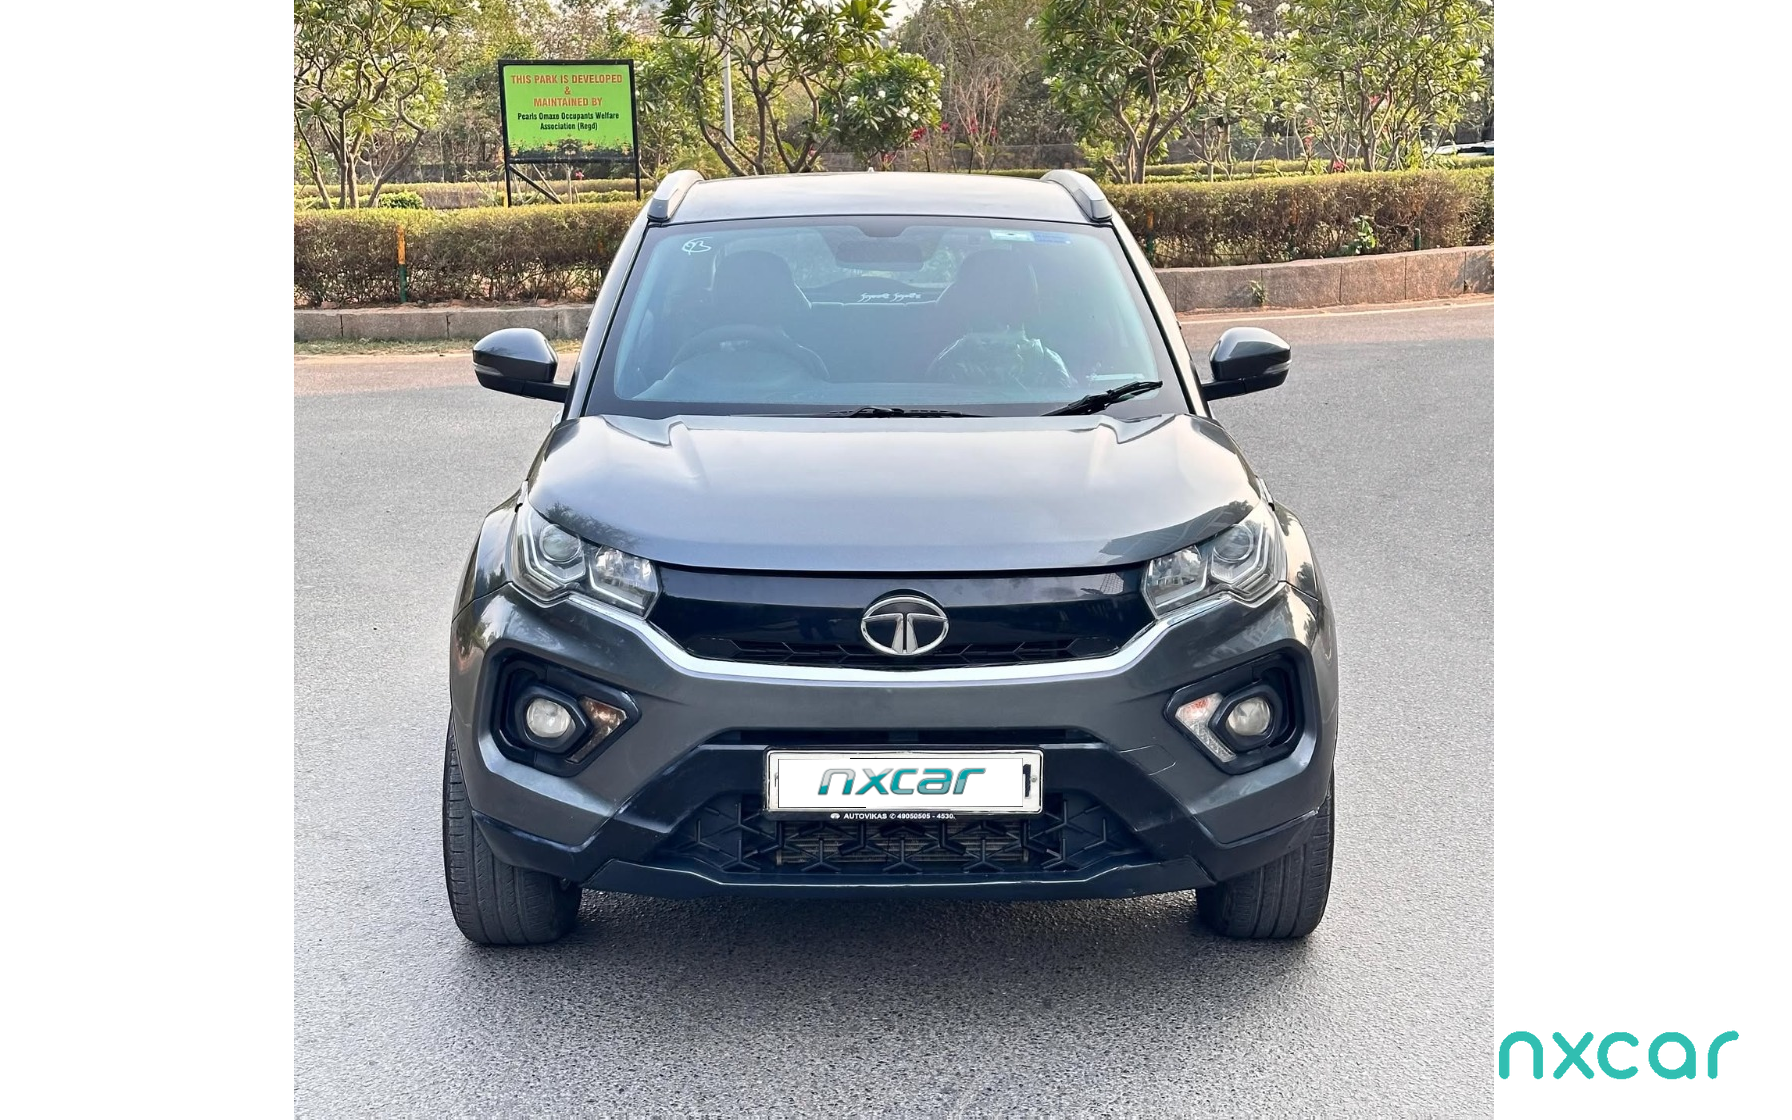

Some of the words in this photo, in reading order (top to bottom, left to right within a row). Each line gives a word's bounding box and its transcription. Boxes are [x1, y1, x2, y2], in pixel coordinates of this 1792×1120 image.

[511, 75, 531, 84] THIS
[534, 75, 558, 84] PARK
[561, 75, 569, 84] IS
[571, 74, 623, 84] DEVELOPED
[564, 86, 571, 95] &
[533, 98, 589, 107] MAINTAINED
[591, 97, 603, 106] BY
[517, 112, 537, 120] Pearls
[561, 112, 594, 121] Occupants
[540, 122, 576, 130] Association
